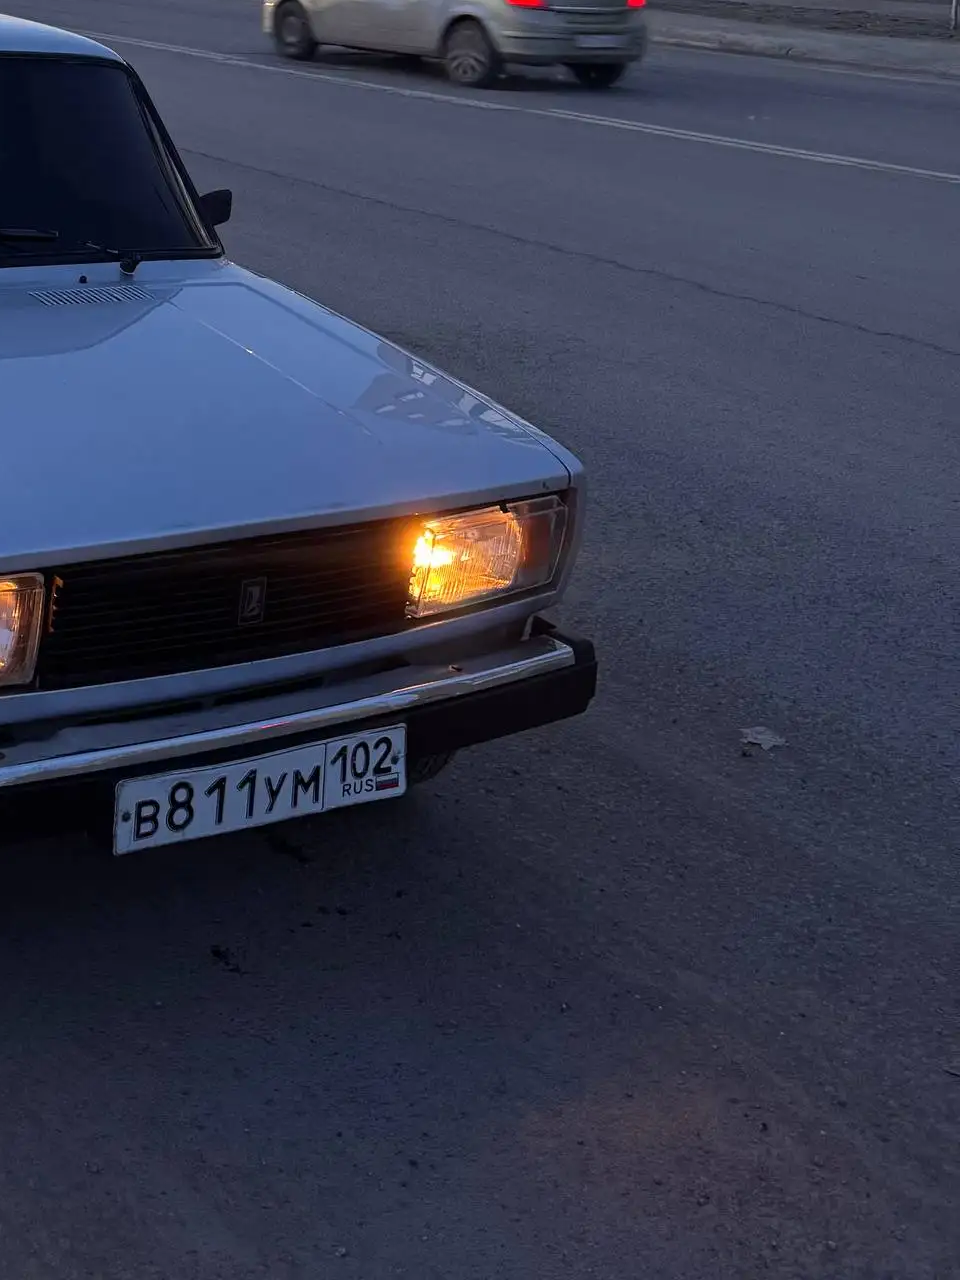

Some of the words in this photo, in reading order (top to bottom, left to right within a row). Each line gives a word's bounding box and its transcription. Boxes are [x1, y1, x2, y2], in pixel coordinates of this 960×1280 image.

[133, 765, 321, 842] В811УМ
[330, 736, 393, 782] 102
[342, 780, 374, 798] RUS
